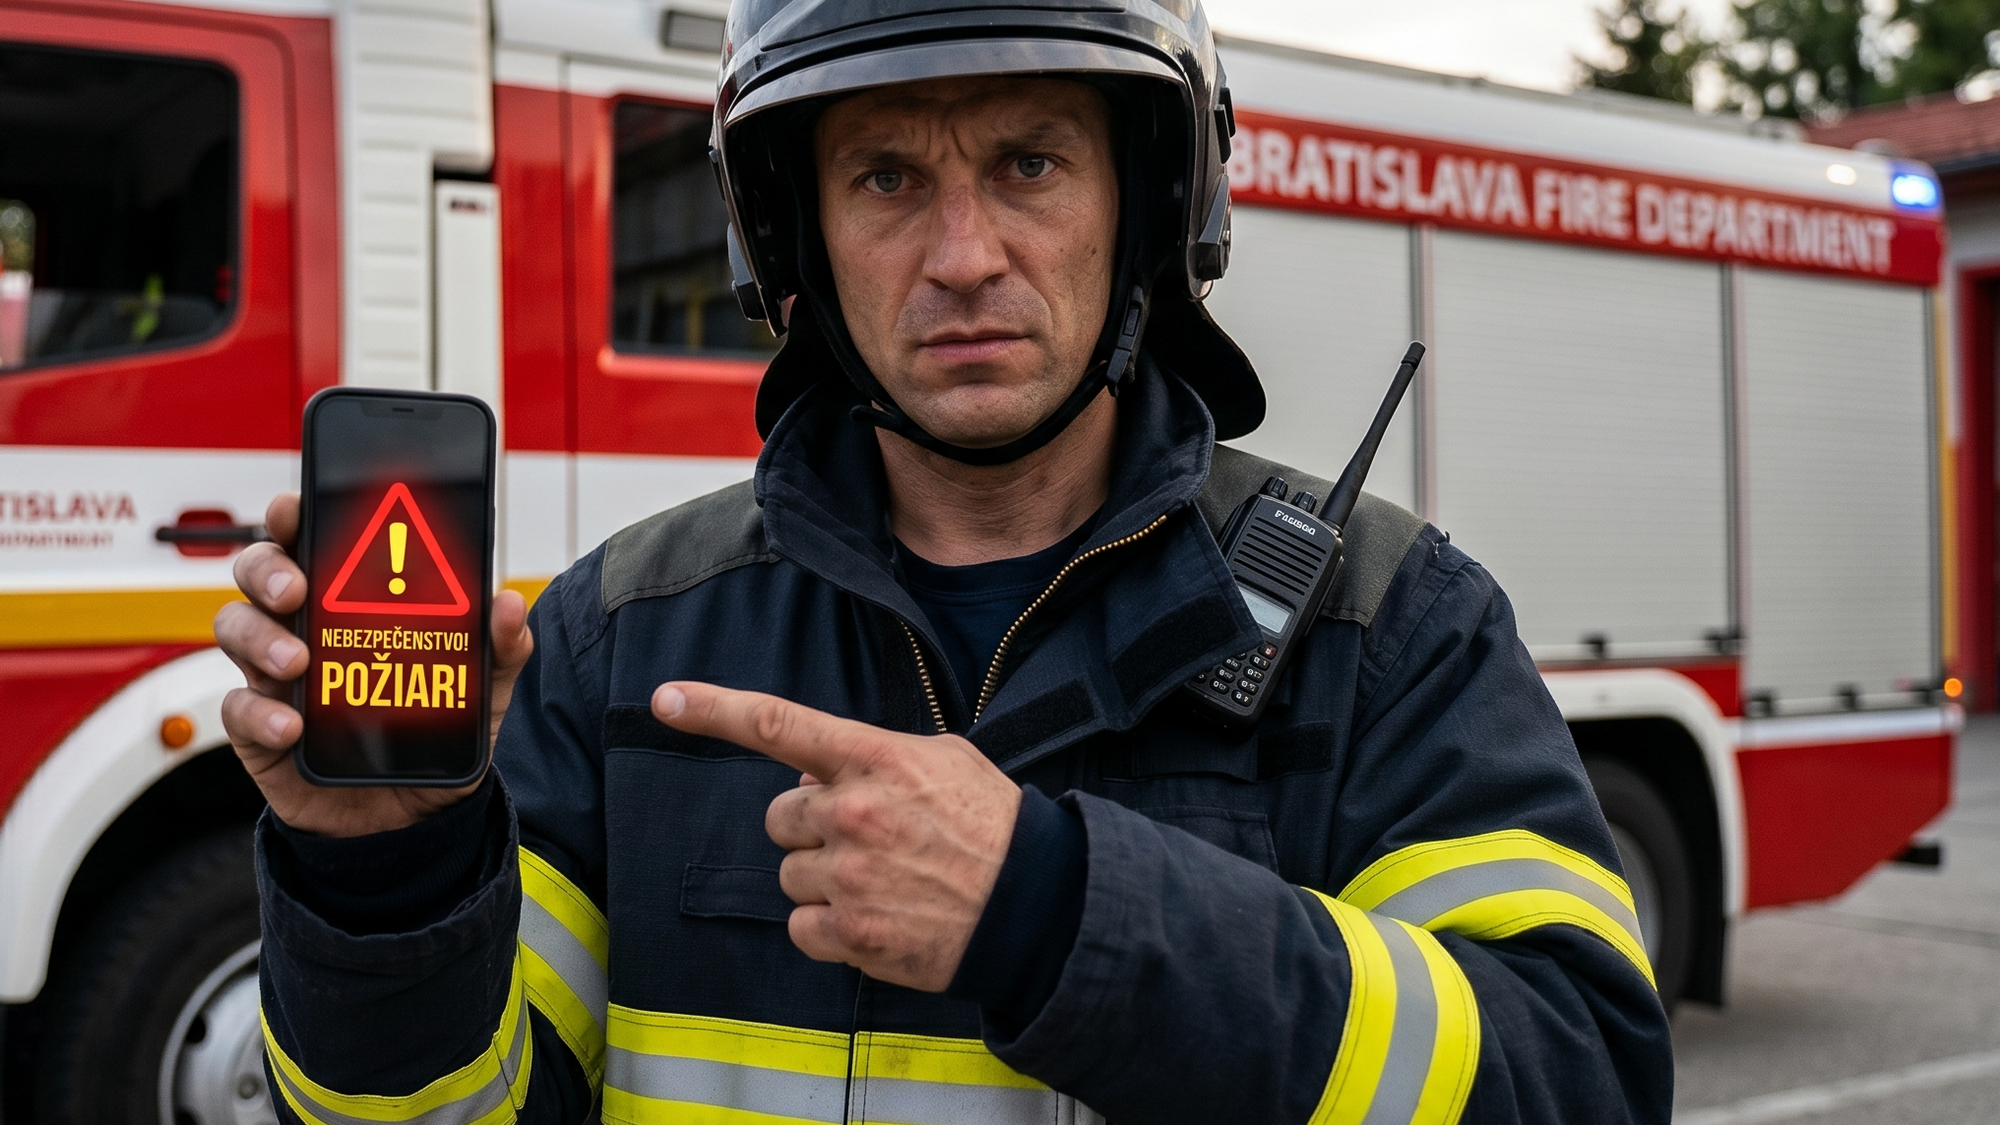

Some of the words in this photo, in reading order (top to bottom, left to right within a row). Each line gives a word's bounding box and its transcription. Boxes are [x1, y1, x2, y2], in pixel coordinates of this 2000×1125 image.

[1228, 122, 1530, 227] BRATISLAVA
[1532, 168, 1634, 241] FIRE
[1635, 182, 1895, 275] DEPARTMENT
[321, 625, 469, 652] NEBEZPEČENSTVO!
[321, 652, 467, 709] POŽIAR!
